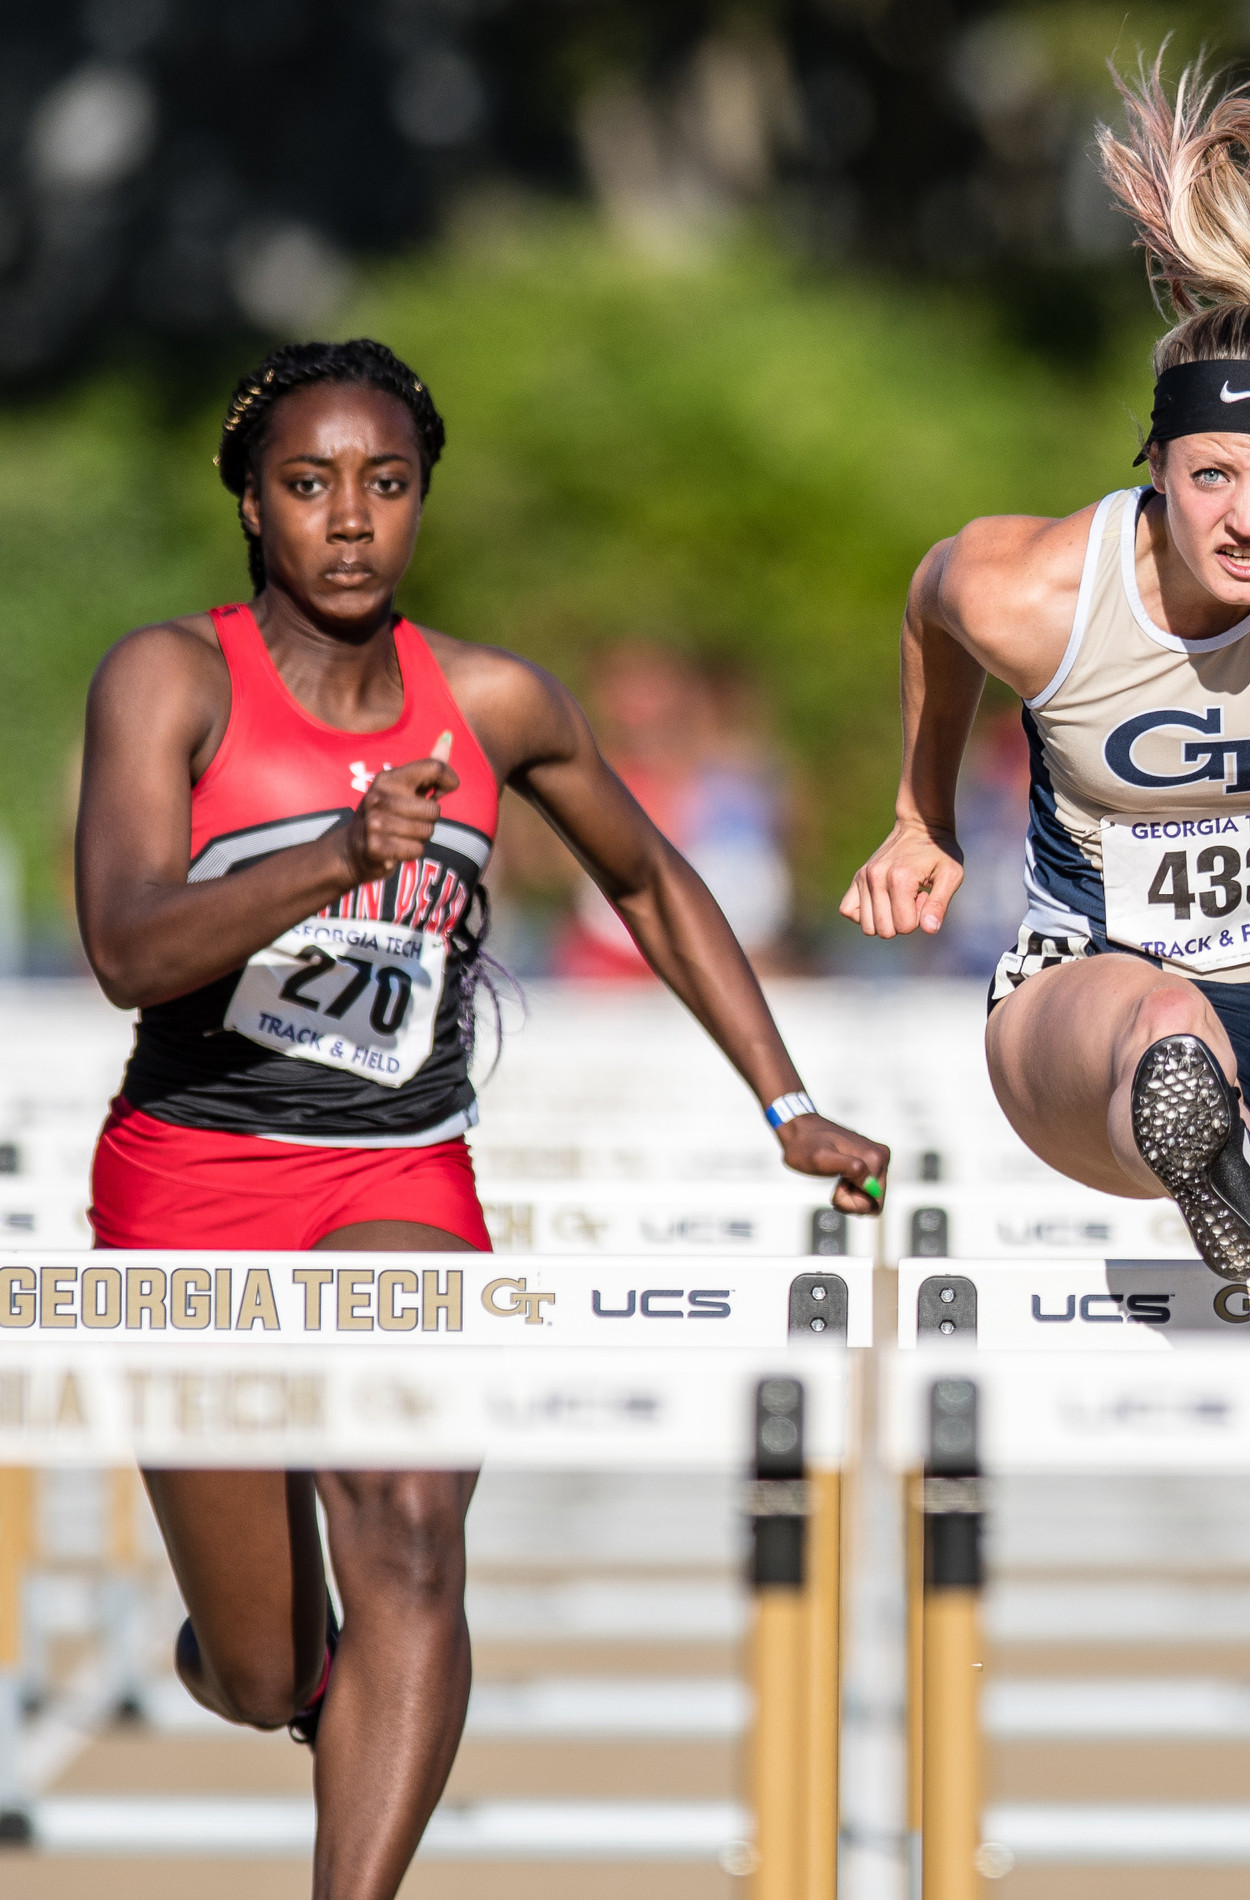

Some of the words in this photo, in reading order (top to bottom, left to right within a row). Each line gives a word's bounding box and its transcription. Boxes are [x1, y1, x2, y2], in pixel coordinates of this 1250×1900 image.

[1131, 816, 1239, 840] GEORGIA
[386, 936, 423, 960] TECH
[1140, 935, 1212, 959] TRACK
[1218, 929, 1234, 948] &
[279, 944, 412, 1036] 270
[257, 1011, 325, 1051] TRACK
[329, 1040, 345, 1060] &
[351, 1046, 401, 1075] FIELD
[0, 1266, 281, 1331] GEORGIA
[292, 1268, 464, 1332] TECH
[592, 1289, 732, 1318] UCS
[1031, 1294, 1172, 1324] UCS
